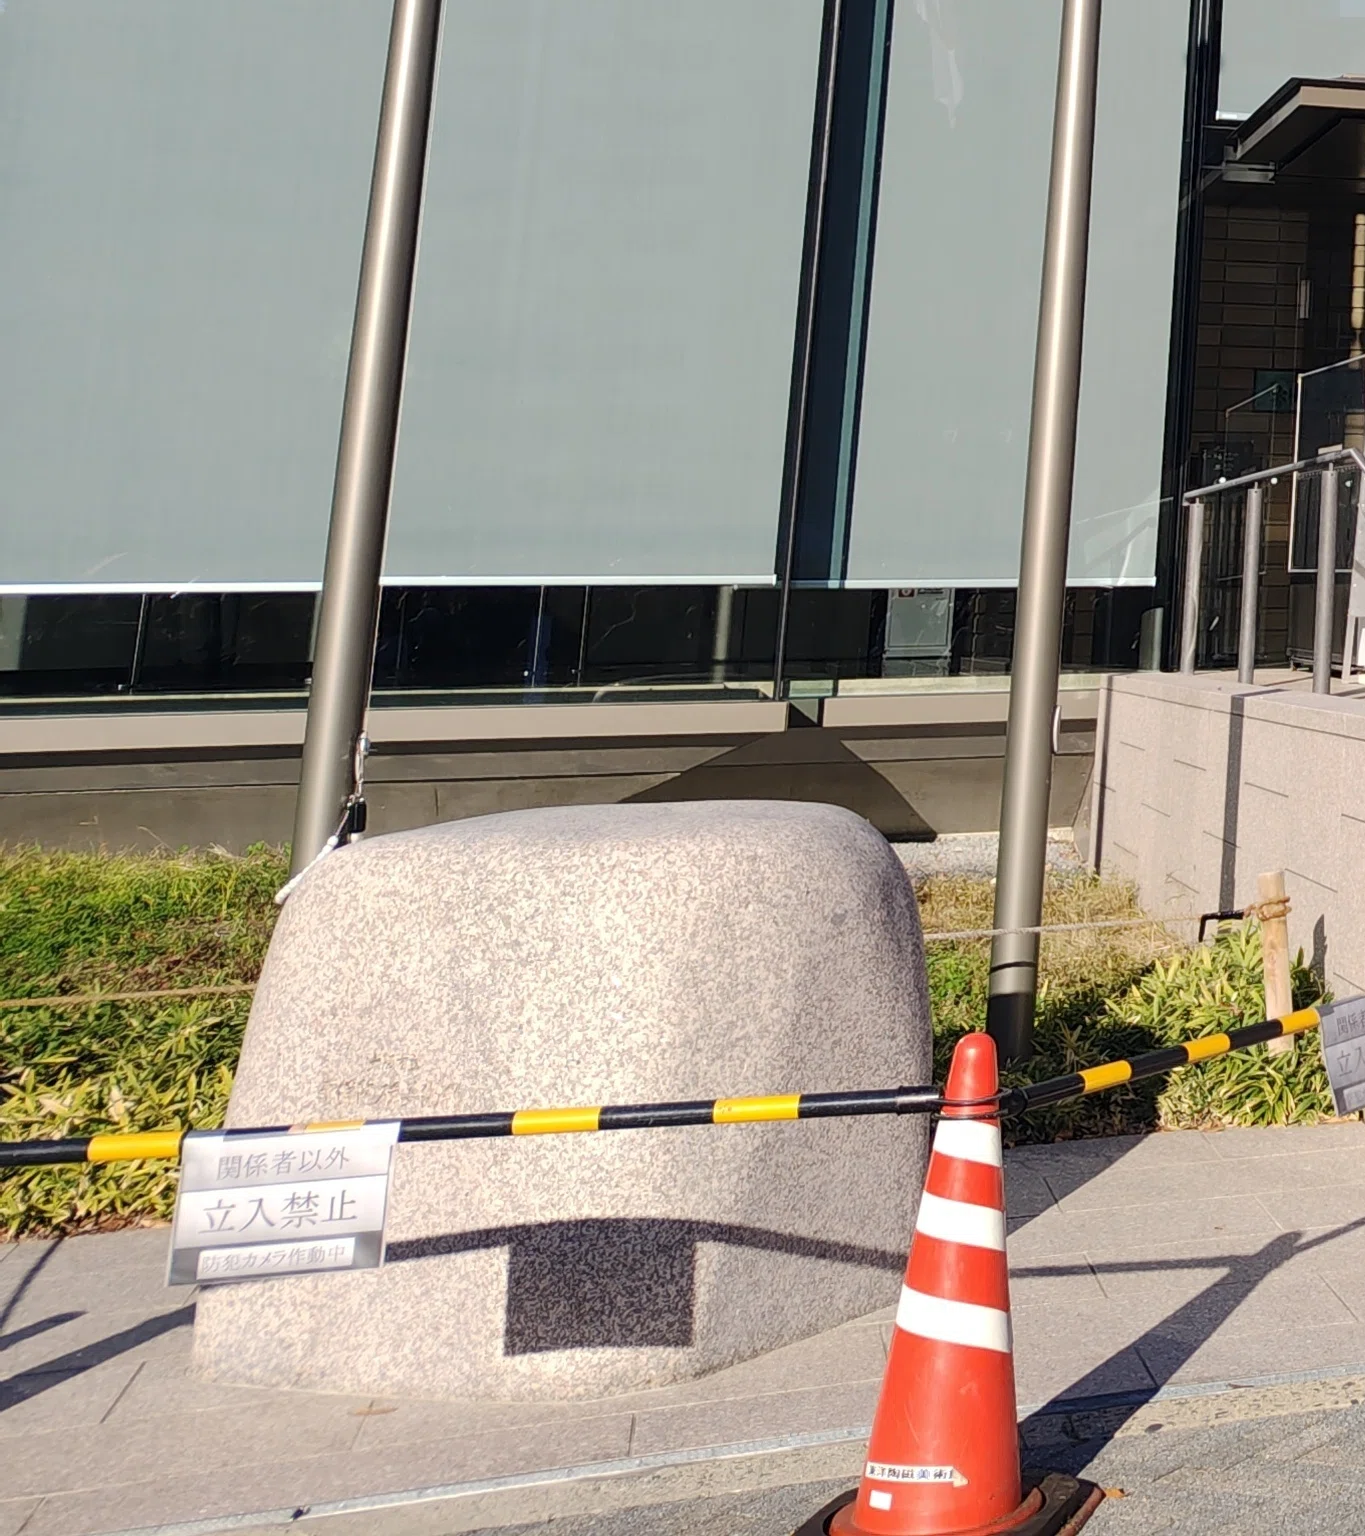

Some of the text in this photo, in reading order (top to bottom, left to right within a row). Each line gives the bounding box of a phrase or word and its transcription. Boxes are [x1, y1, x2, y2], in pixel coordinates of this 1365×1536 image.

[215, 1146, 351, 1181] 関係者以外
[197, 1189, 358, 1234] 立入禁止
[201, 1244, 347, 1273] 防犯カメラ作動中
